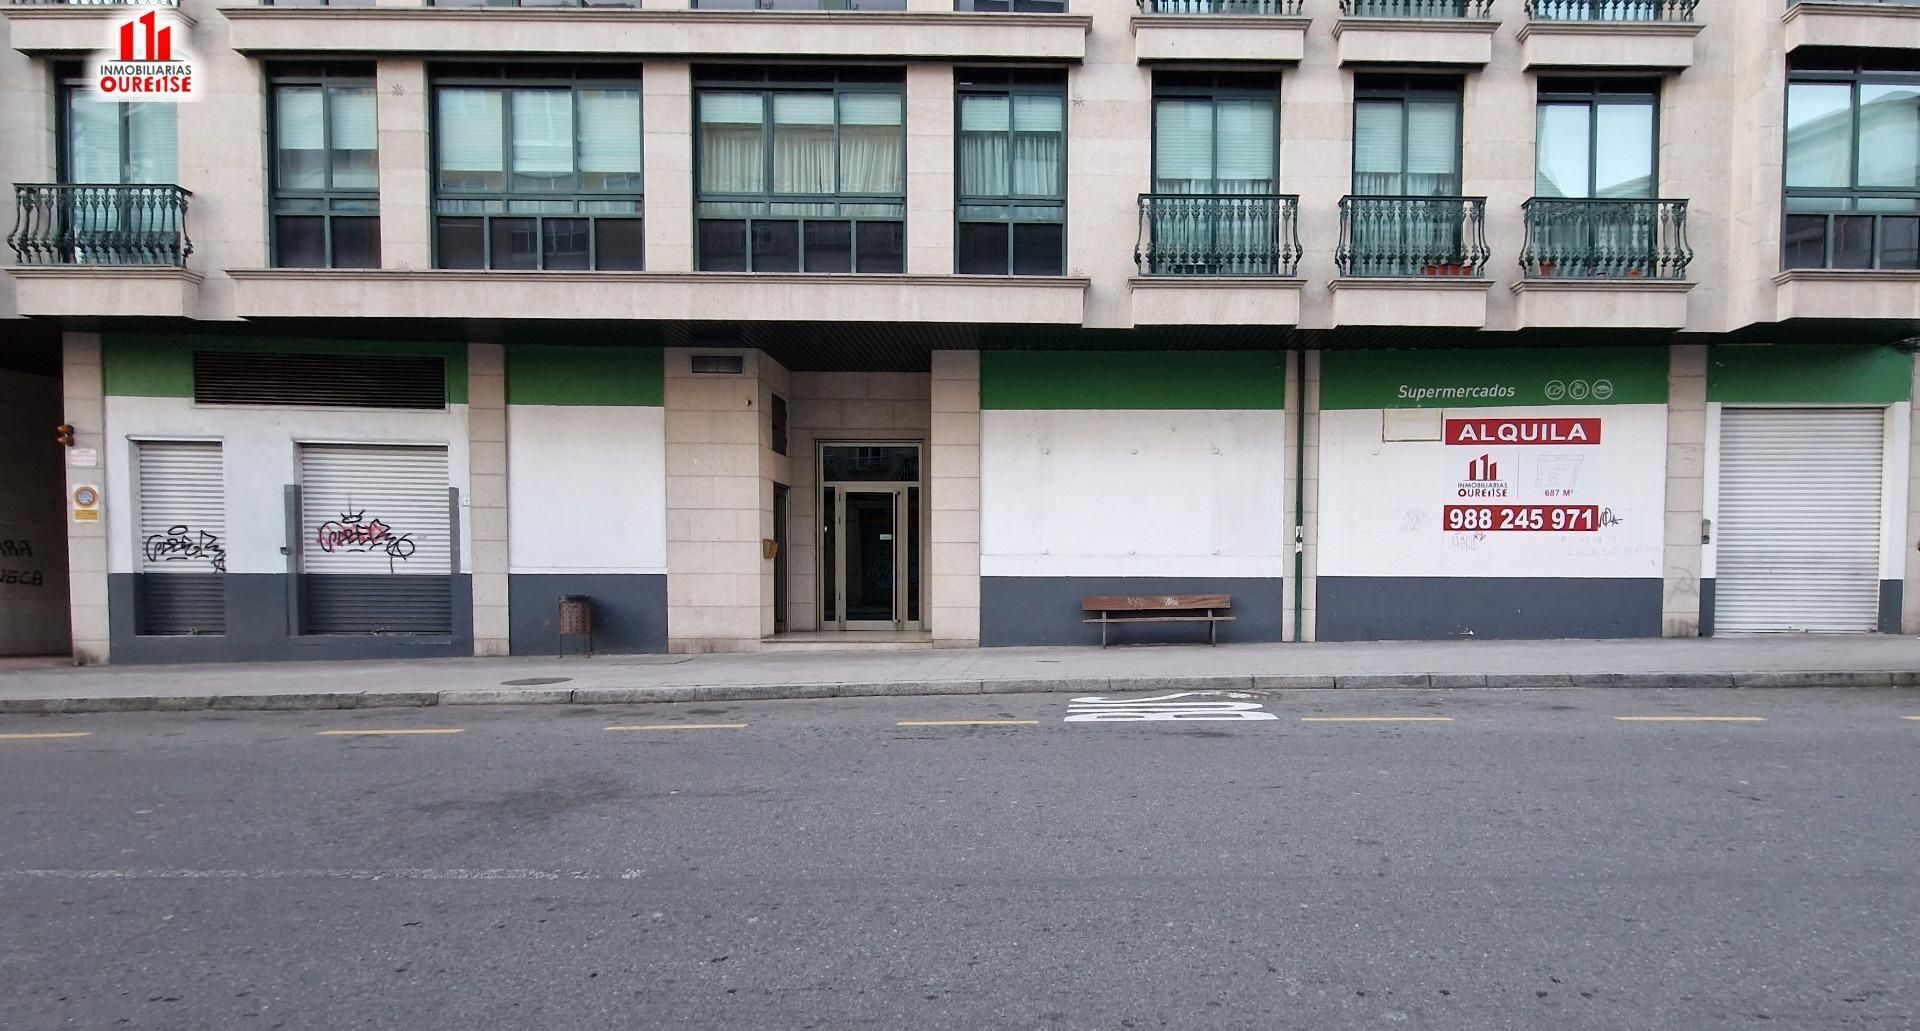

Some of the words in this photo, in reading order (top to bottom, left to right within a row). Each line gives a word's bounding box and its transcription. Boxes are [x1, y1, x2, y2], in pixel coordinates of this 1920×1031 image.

[1397, 384, 1516, 401] Supermercados
[1458, 423, 1588, 443] ALQUILA
[1544, 489, 1560, 497] 687
[1449, 508, 1493, 530] 988
[1500, 508, 1544, 530] 245
[1551, 508, 1593, 530] 971
